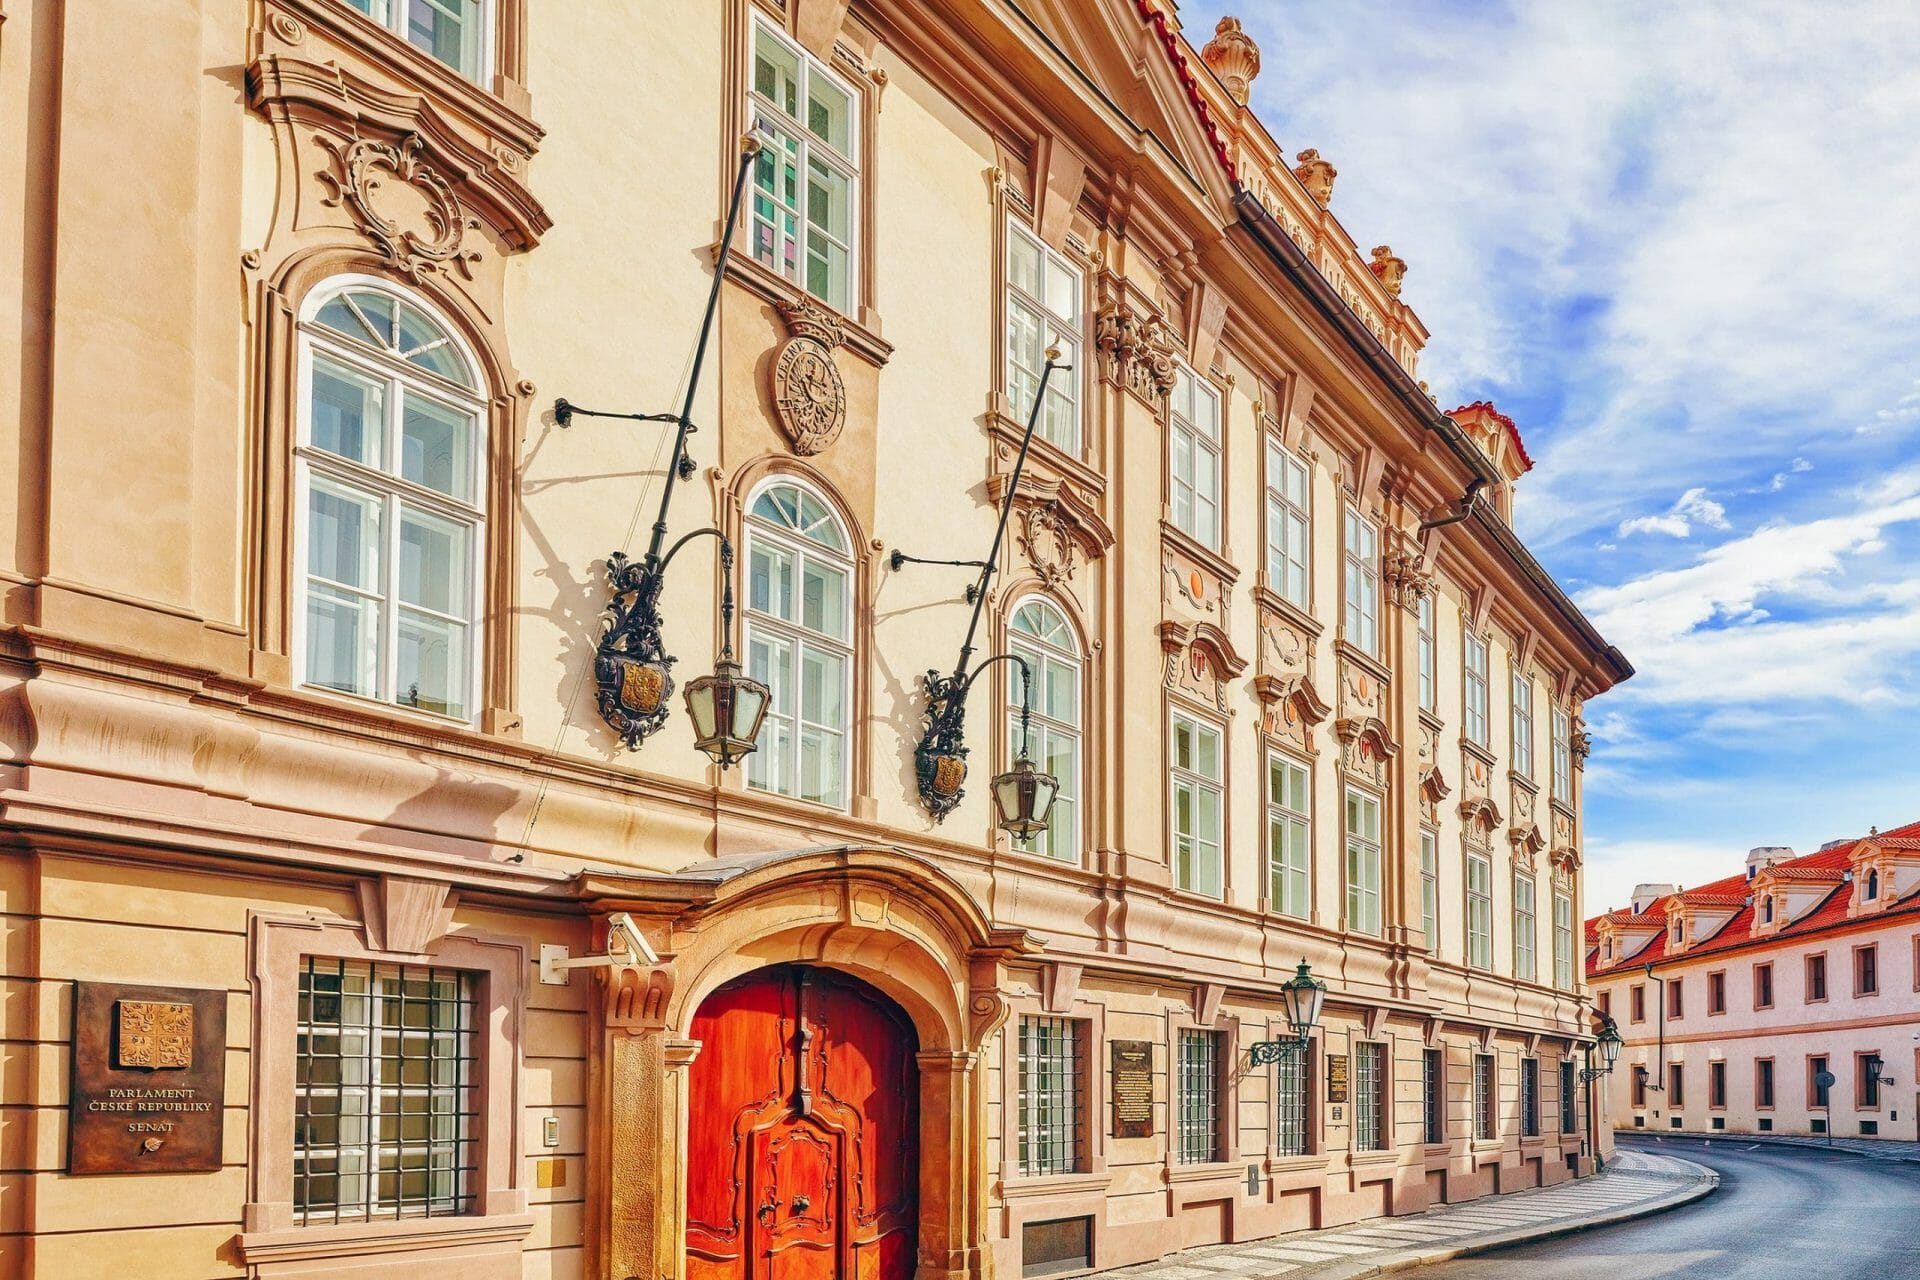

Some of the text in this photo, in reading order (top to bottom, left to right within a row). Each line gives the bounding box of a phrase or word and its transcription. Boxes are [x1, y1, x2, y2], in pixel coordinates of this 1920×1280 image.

[109, 1089, 195, 1098] PARLAMENT
[89, 1100, 212, 1112] ČESKÉ REPUBLIKY
